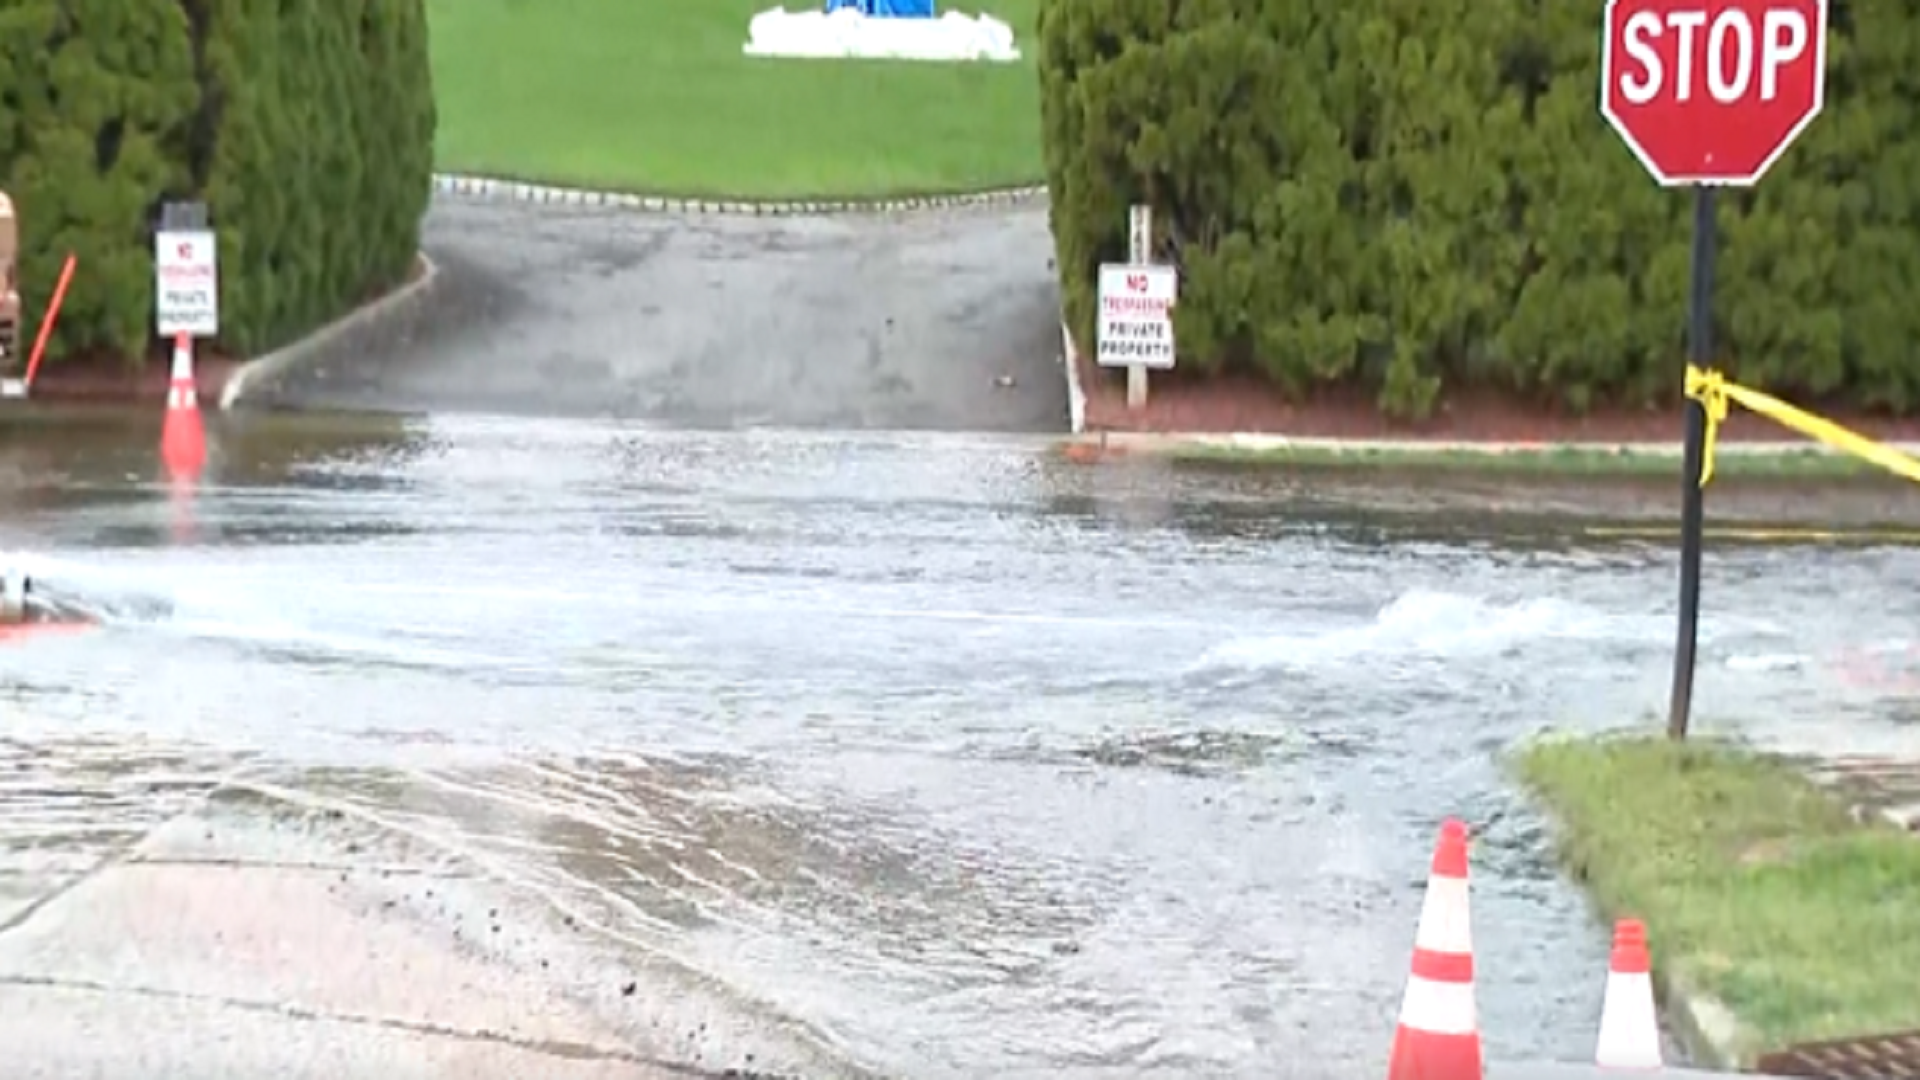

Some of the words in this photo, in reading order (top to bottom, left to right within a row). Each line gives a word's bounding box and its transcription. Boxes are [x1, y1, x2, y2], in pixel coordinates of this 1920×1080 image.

[1620, 9, 1808, 104] STOP
[1126, 274, 1148, 293] NO
[1109, 321, 1164, 339] PRIVATE
[1100, 340, 1171, 356] PROPERTY
